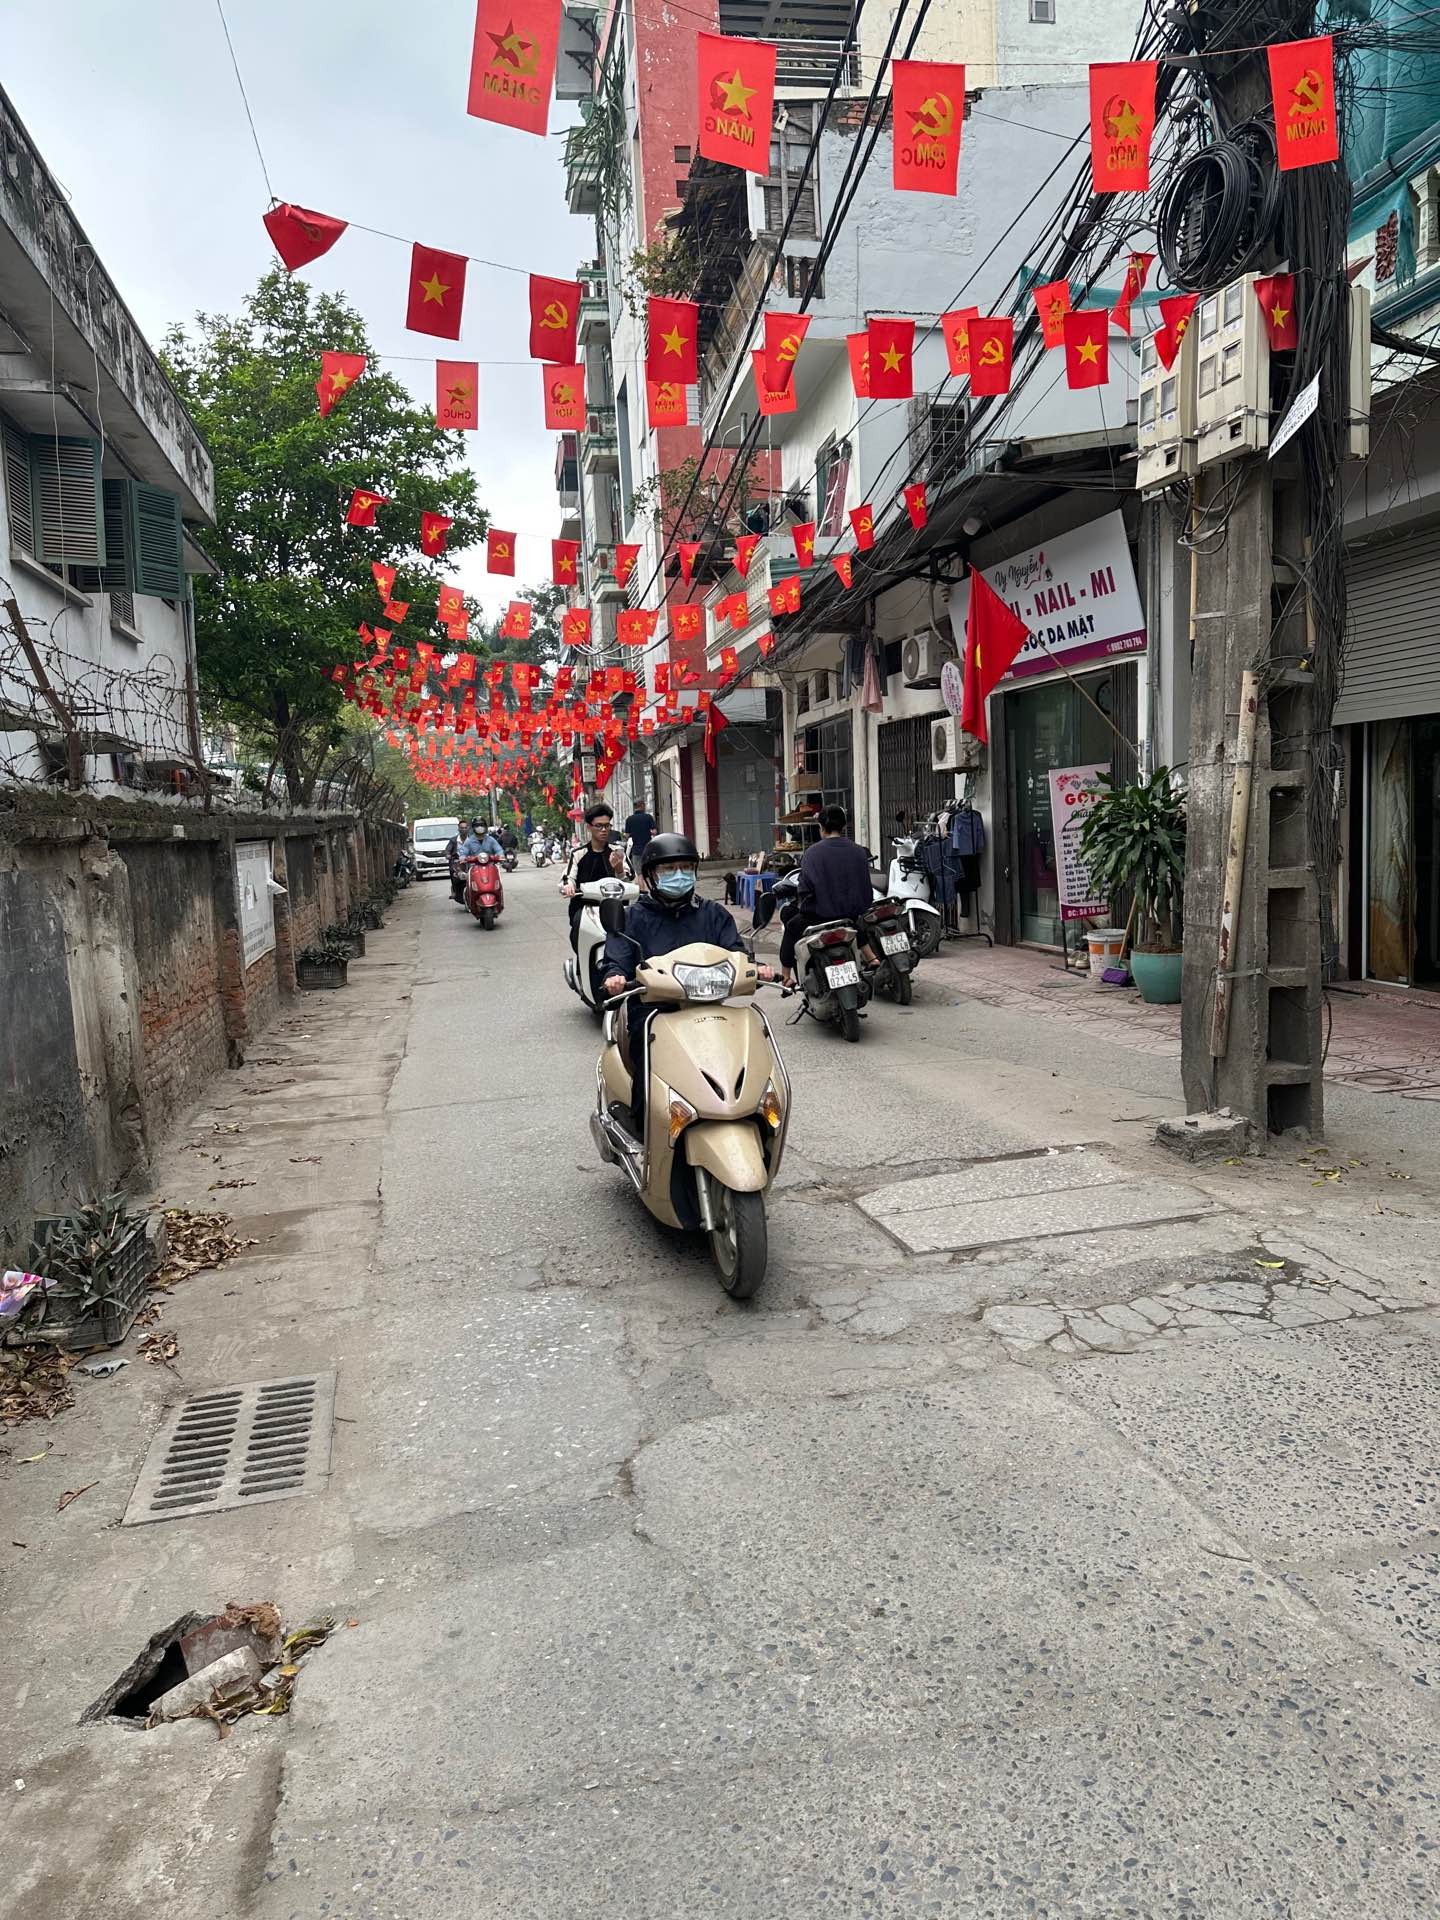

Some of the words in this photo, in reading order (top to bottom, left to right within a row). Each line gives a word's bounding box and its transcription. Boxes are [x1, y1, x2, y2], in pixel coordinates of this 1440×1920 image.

[1034, 582, 1076, 617] NAIL
[1090, 566, 1117, 599] MI
[1047, 625, 1066, 644] DA
[1067, 614, 1096, 639] MẶT
